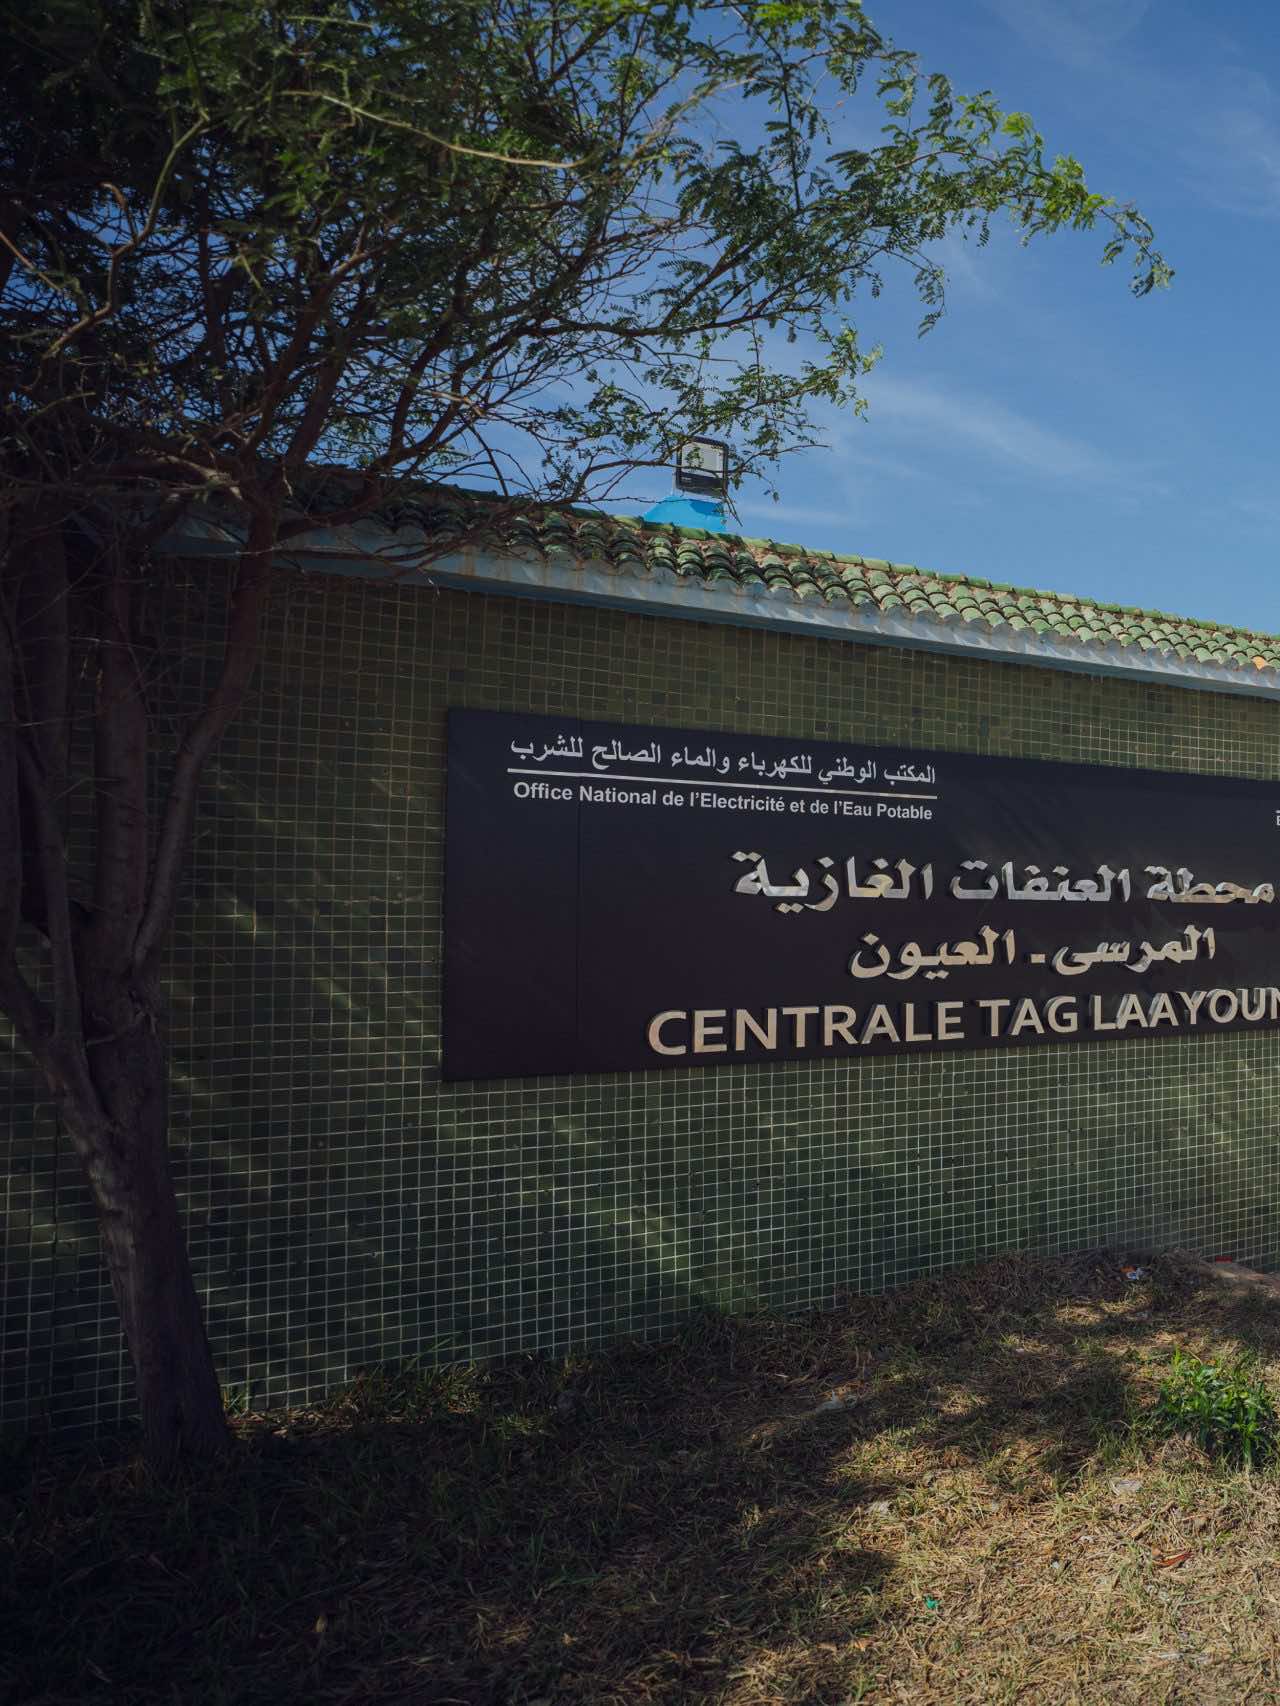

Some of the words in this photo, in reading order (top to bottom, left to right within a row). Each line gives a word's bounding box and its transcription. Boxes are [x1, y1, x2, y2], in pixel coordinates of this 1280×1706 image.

[510, 735, 584, 760] للشرب
[591, 742, 661, 770] الصالح
[671, 747, 730, 774] والماء
[737, 755, 812, 778] للكهرباء
[818, 758, 877, 784] الوطني
[884, 765, 936, 785] المكتب
[513, 781, 573, 801] Office
[579, 785, 657, 805] National
[662, 790, 685, 807] de
[789, 799, 806, 814] et
[809, 799, 829, 815] de
[876, 803, 933, 820] Potable
[732, 851, 932, 914] الغازية
[951, 860, 1131, 903] العنفات
[1143, 866, 1275, 904] محطة
[851, 925, 1017, 980] العيون
[648, 1001, 965, 1056] CENTRALE
[980, 995, 1079, 1038] TAG
